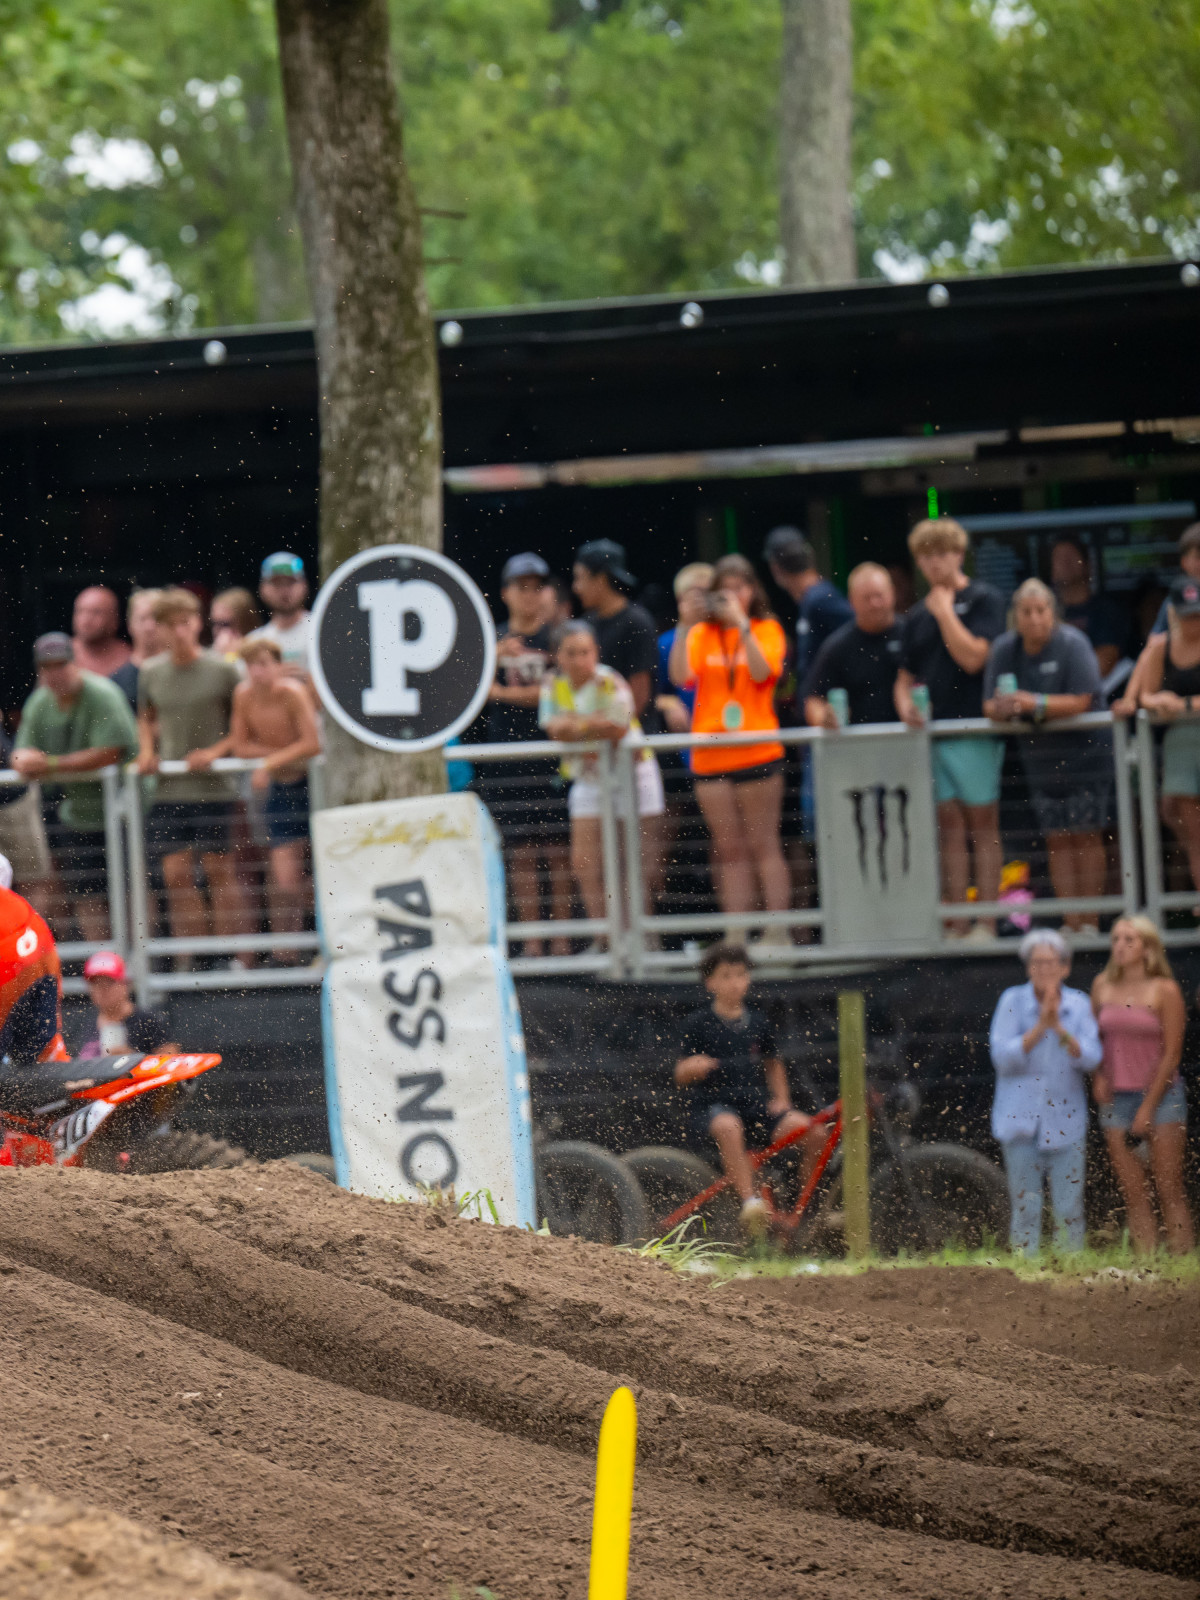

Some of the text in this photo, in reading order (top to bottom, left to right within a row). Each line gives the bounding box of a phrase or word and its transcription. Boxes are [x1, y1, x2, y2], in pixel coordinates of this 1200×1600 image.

[357, 576, 458, 716] P
[373, 877, 446, 1050] PASS
[396, 1069, 460, 1188] NO
